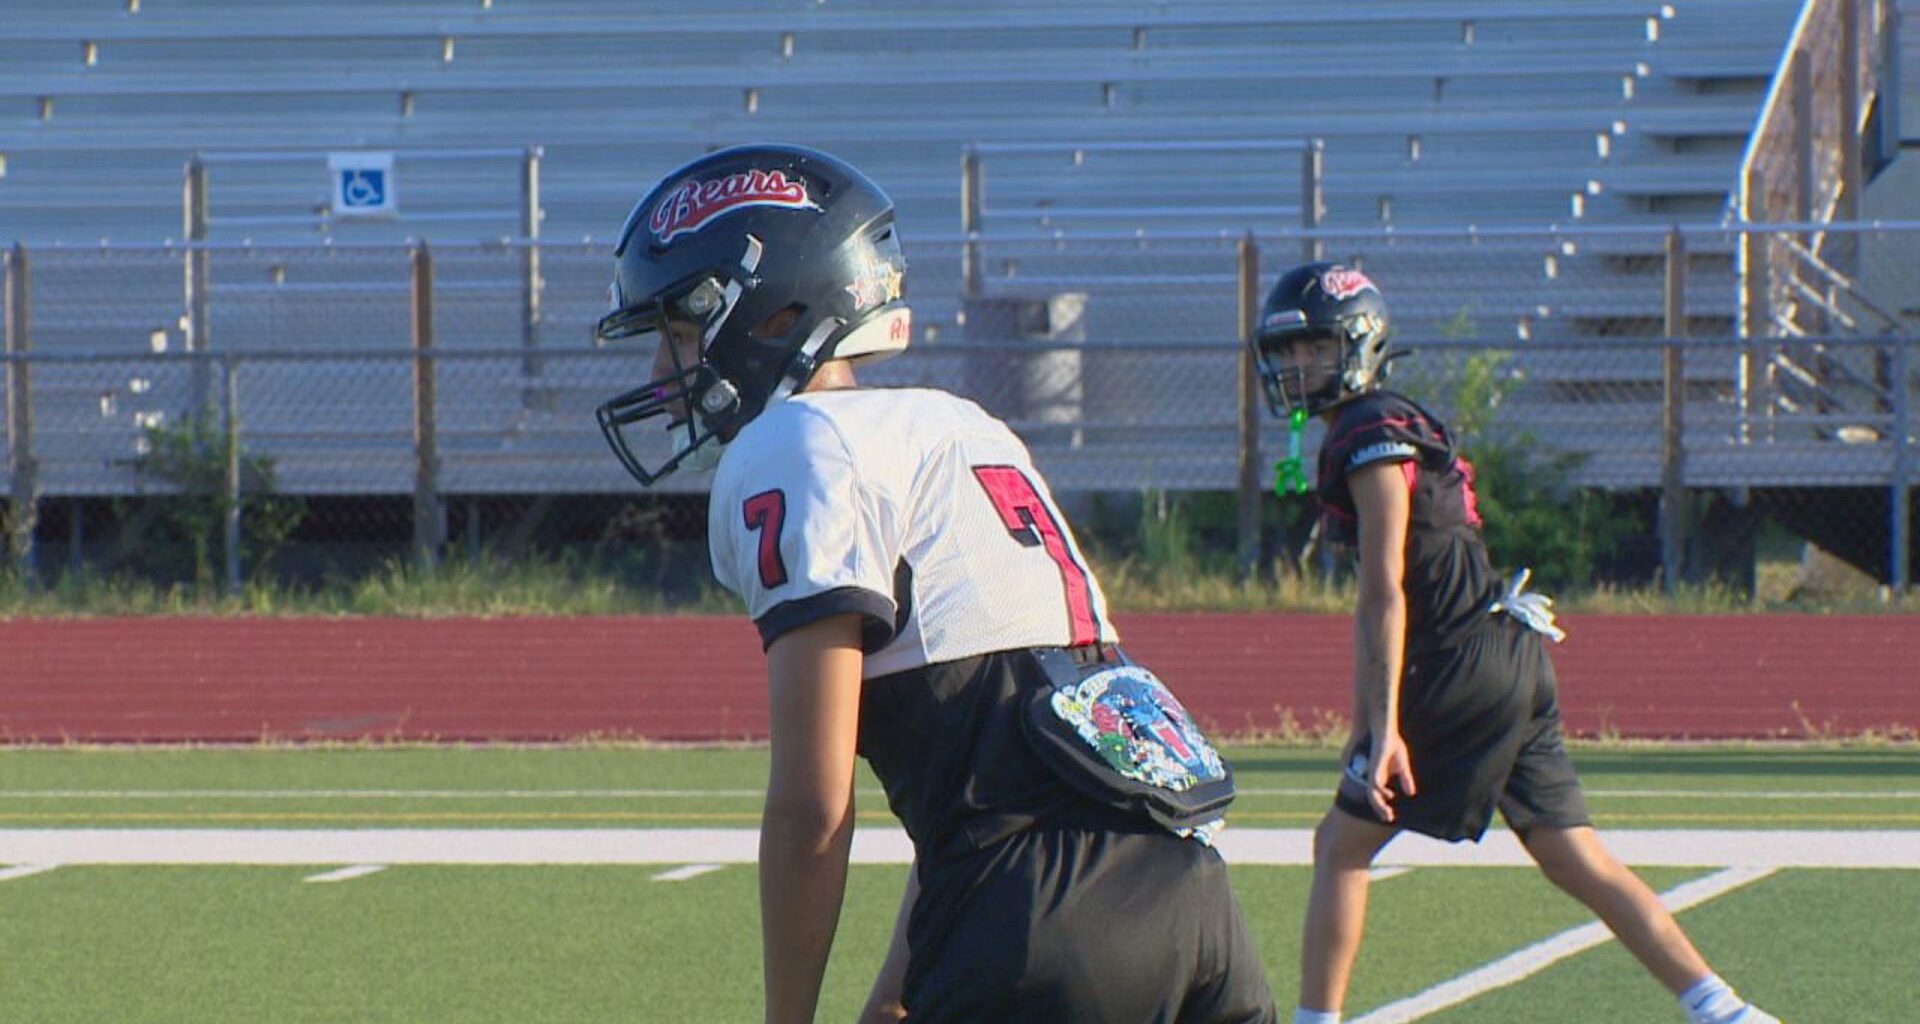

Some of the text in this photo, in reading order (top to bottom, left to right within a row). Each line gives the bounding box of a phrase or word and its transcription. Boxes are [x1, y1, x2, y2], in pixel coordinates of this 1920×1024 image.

[649, 169, 810, 243] Bears
[742, 488, 788, 591] 7
[971, 464, 1101, 649] 7
